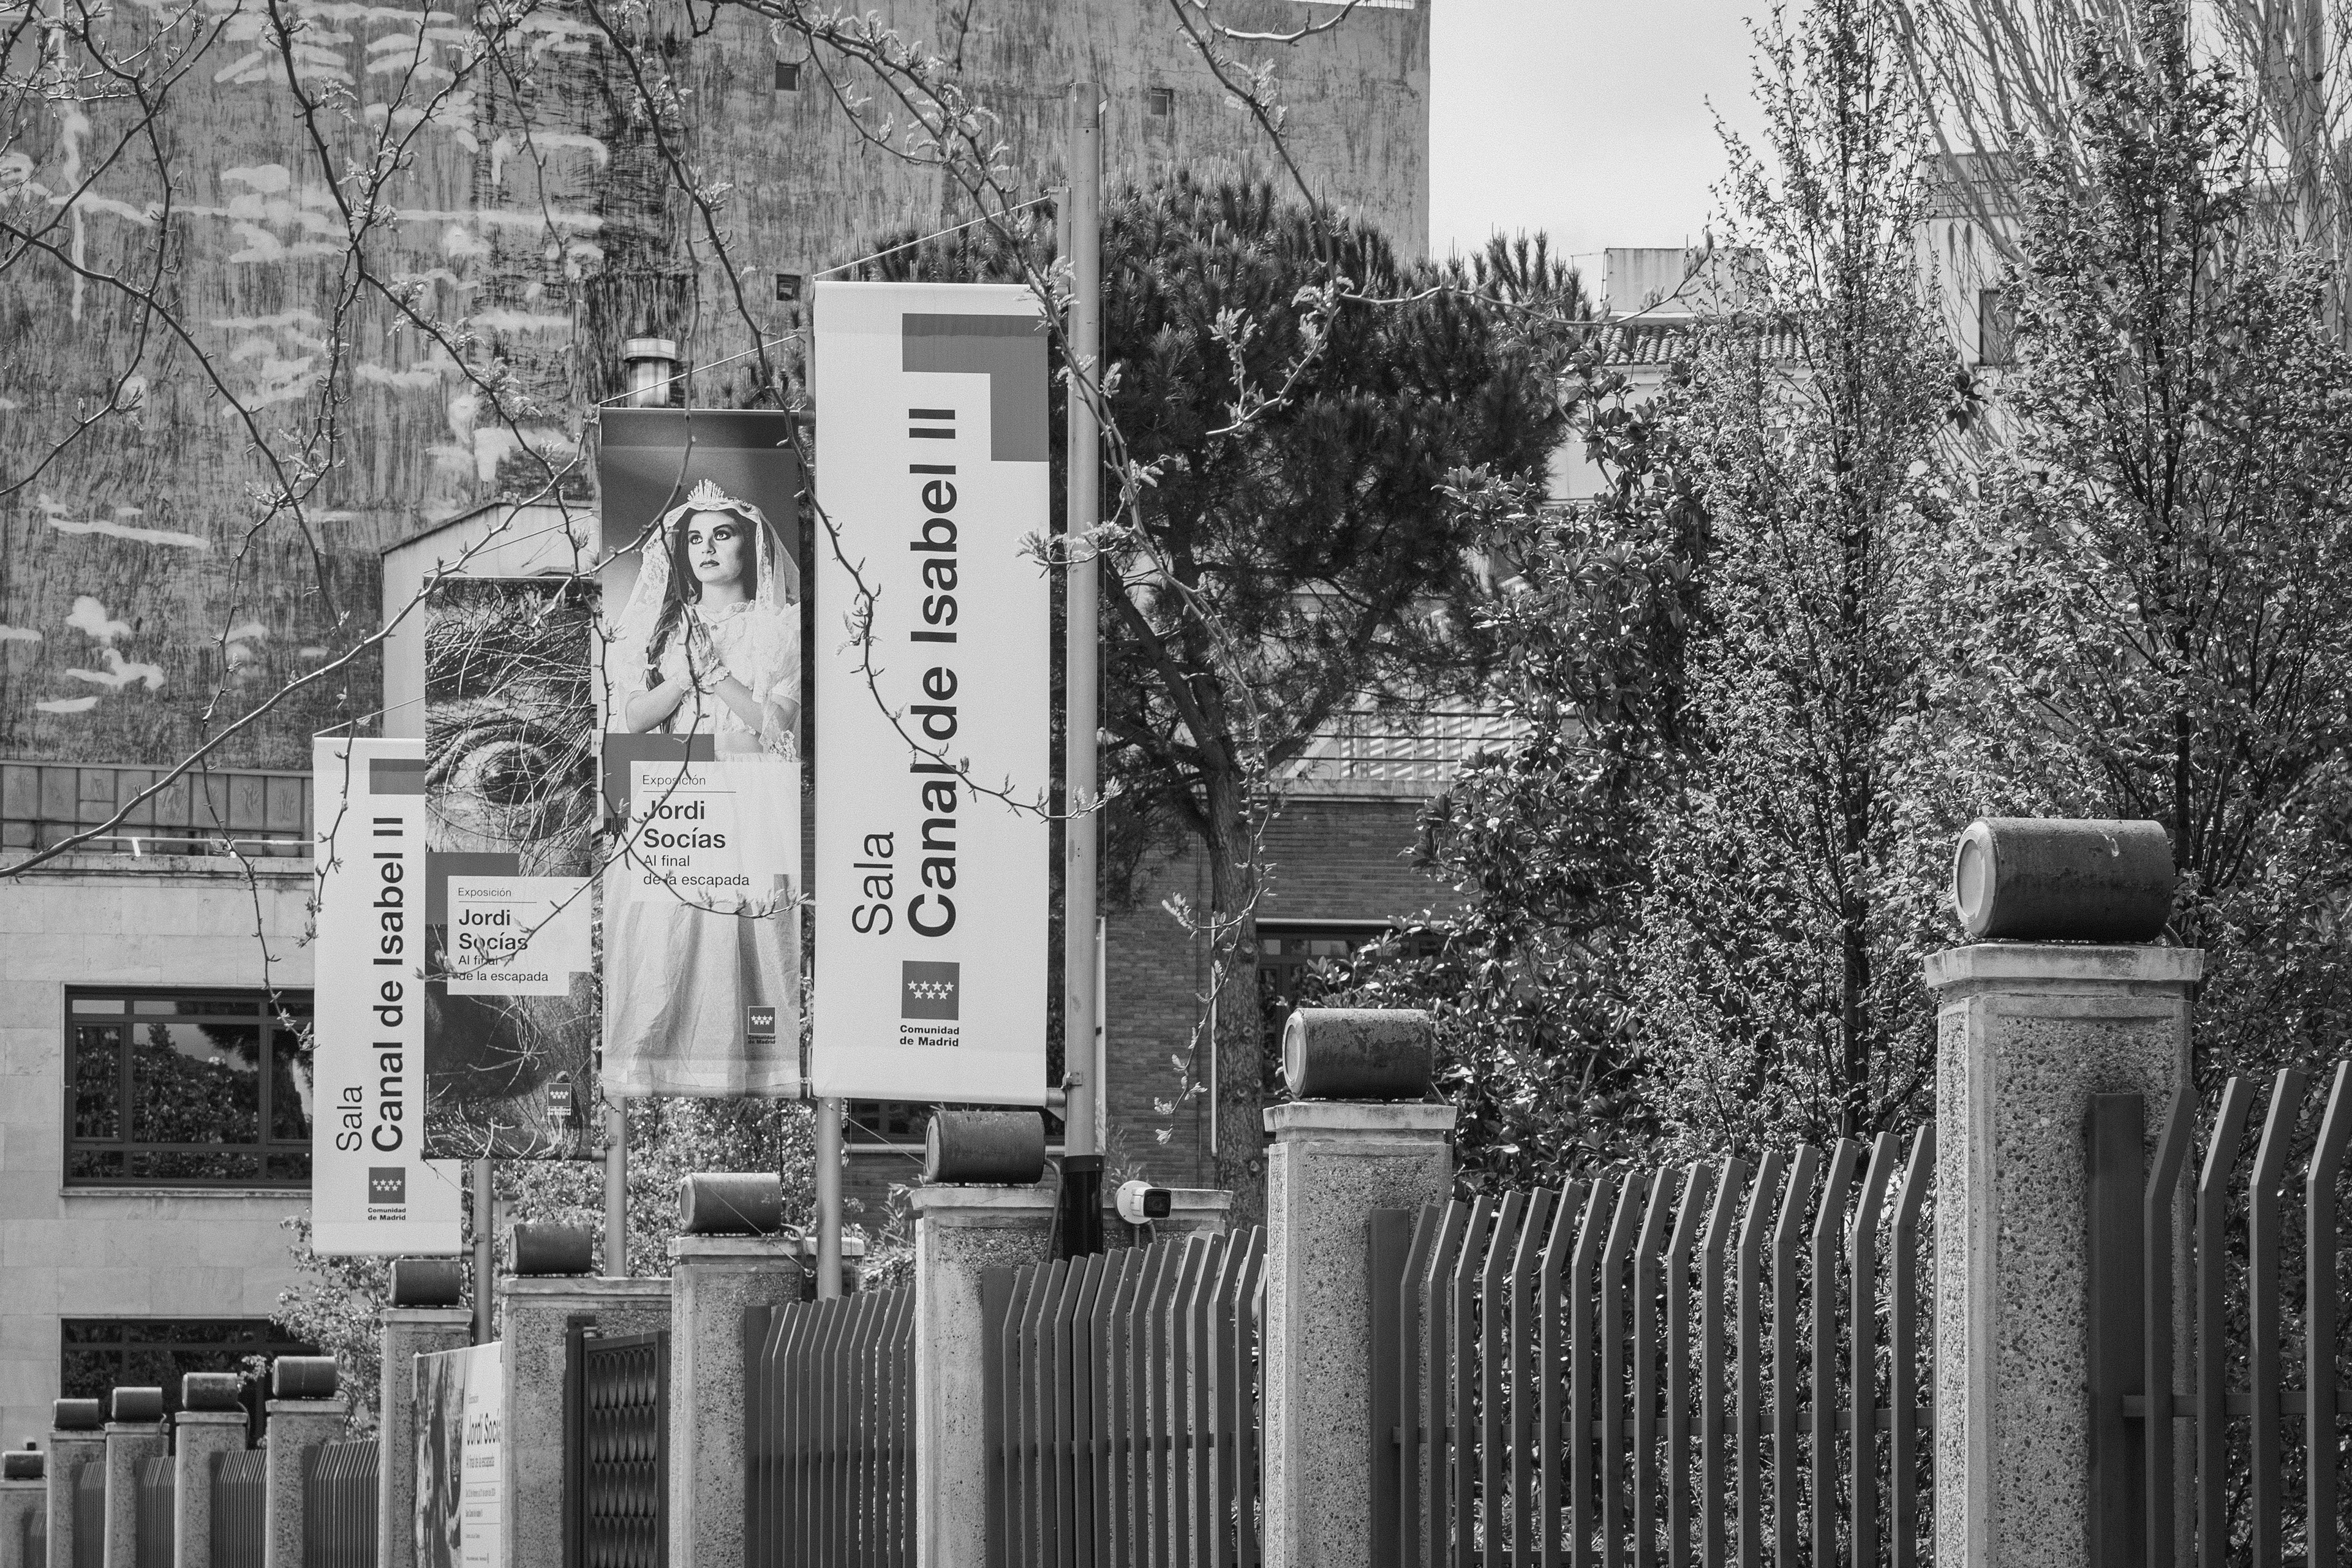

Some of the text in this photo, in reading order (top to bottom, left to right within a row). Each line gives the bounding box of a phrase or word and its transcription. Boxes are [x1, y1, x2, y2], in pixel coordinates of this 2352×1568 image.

[908, 409, 958, 937] Canal de Isabel II
[643, 800, 704, 820] Jordi
[644, 827, 726, 848] Socías
[644, 855, 690, 867] Al final
[644, 873, 660, 885] de
[682, 874, 750, 888] escapada
[852, 832, 894, 935] Sala
[458, 888, 511, 898] Exposición
[459, 909, 511, 925] Jordi
[459, 932, 528, 950] Socías
[458, 955, 470, 965] Al
[372, 818, 404, 1152] Canal de Isabel II
[459, 971, 548, 983] de la escapada
[900, 1025, 960, 1035] Comunidad
[900, 1036, 959, 1047] de Madrid
[336, 1085, 363, 1152] Sala
[467, 1414, 483, 1446] Jordi
